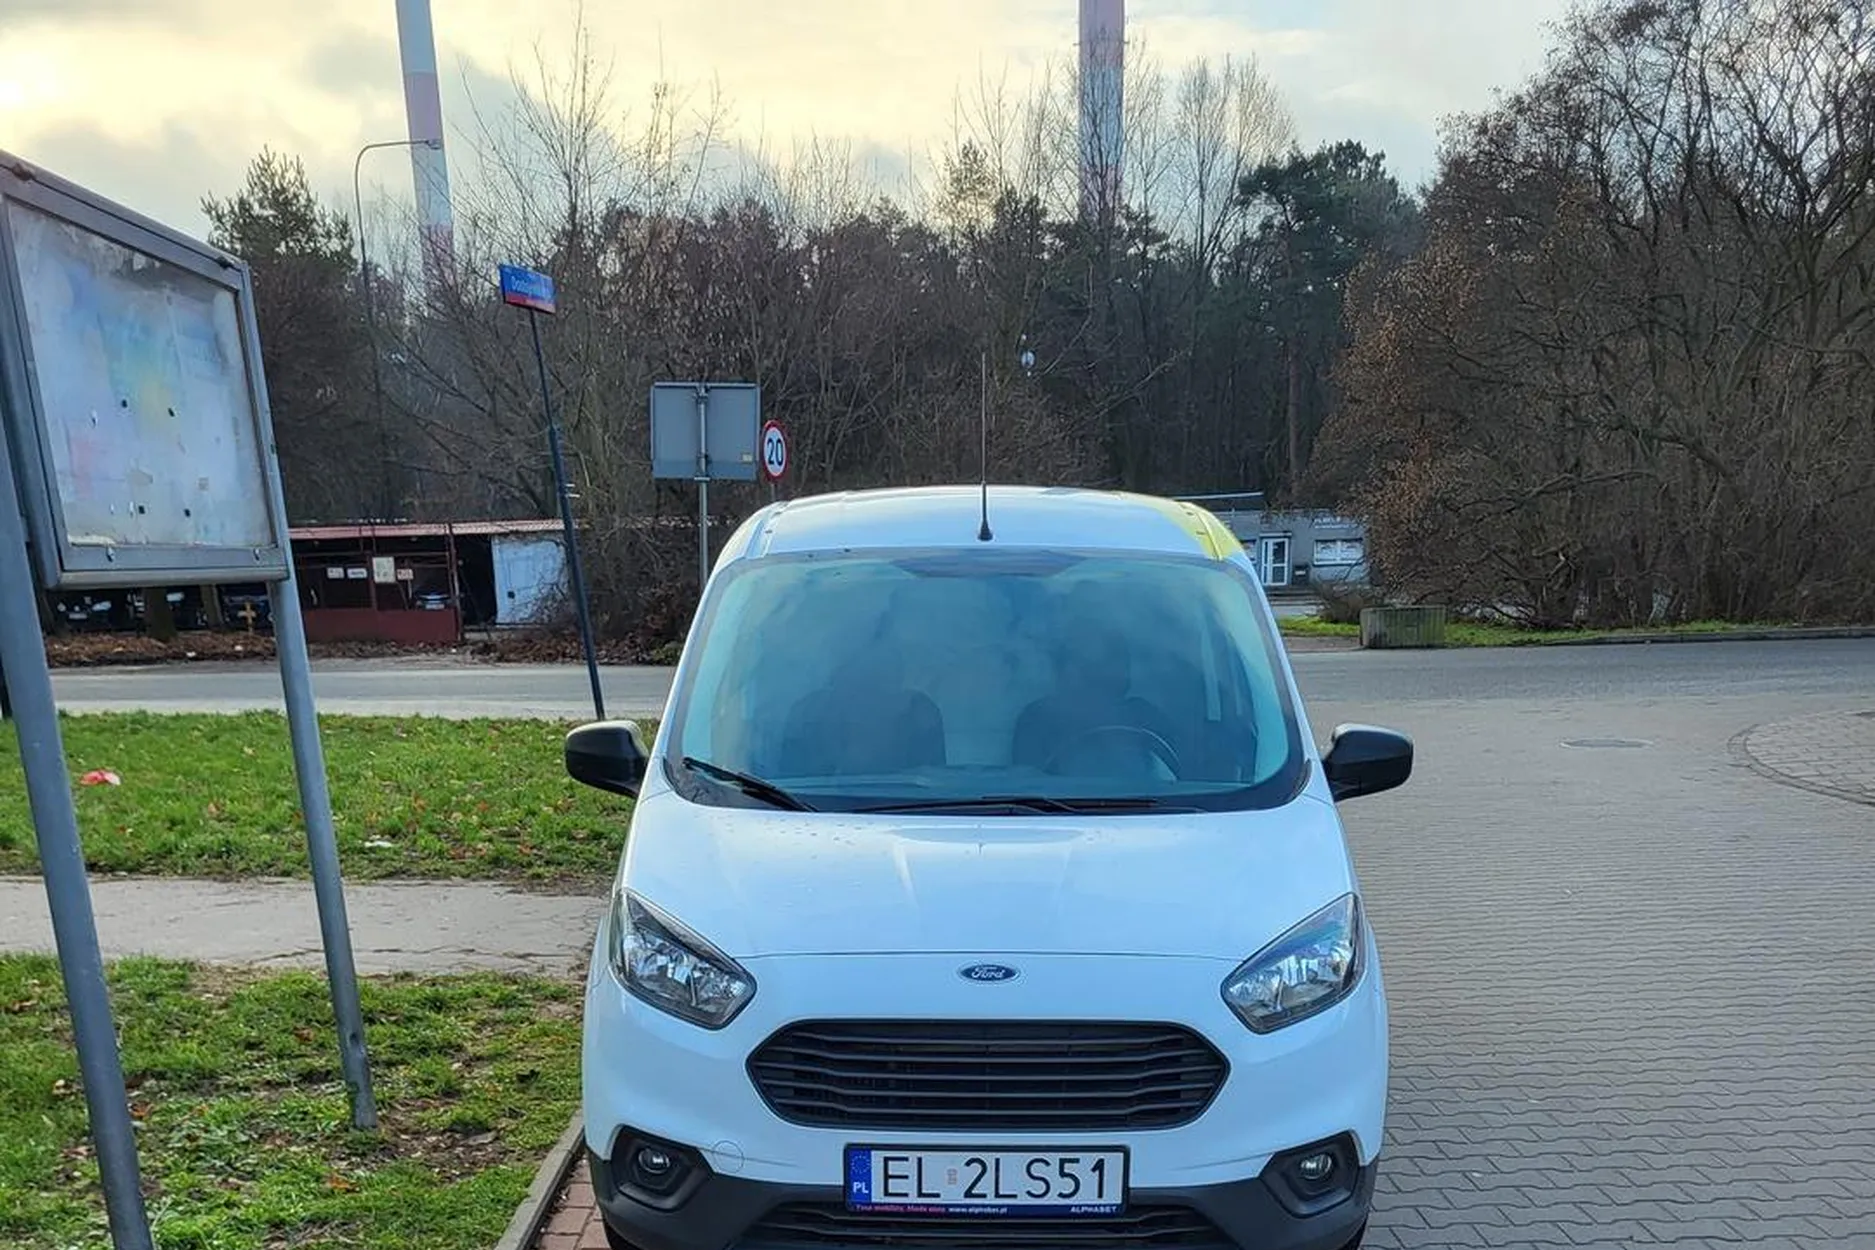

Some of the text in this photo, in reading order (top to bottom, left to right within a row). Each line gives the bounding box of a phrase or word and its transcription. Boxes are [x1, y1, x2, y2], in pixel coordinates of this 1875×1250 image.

[766, 438, 784, 466] 20
[971, 966, 1006, 979] Ford
[852, 1181, 869, 1194] PL
[883, 1156, 1106, 1199] EL 2LS51
